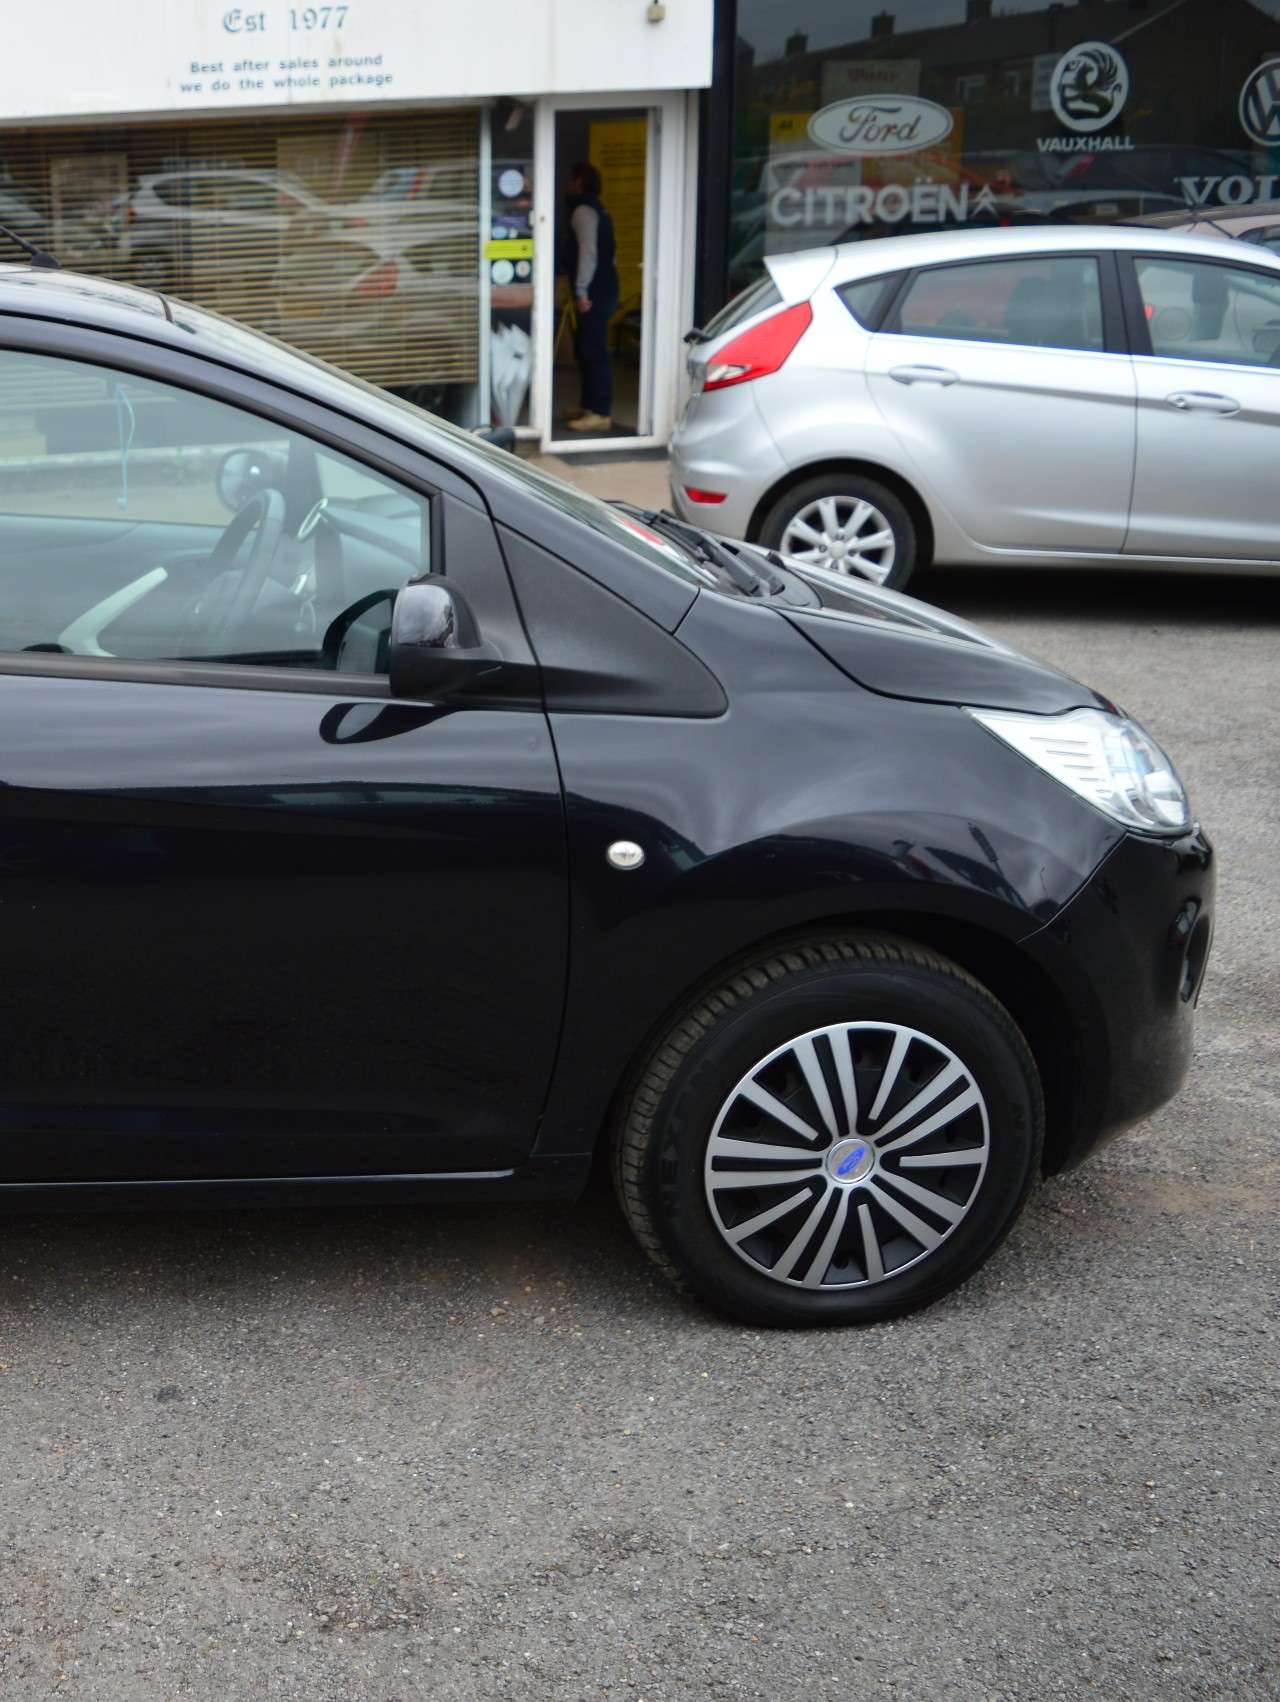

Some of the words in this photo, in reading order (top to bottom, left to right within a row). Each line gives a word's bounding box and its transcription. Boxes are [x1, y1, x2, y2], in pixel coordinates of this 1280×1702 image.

[222, 8, 267, 33] Est
[289, 6, 349, 31] 1977
[190, 61, 224, 74] Best
[233, 59, 269, 72] after
[279, 56, 320, 70] sales
[328, 53, 383, 68] around
[180, 82, 202, 92] we
[211, 79, 230, 91] do
[239, 77, 264, 89] the
[274, 75, 321, 88] whole
[329, 73, 393, 88] package
[839, 105, 922, 143] Ford
[1036, 135, 1135, 153] VAUXHALL
[771, 176, 970, 227] CITROËN
